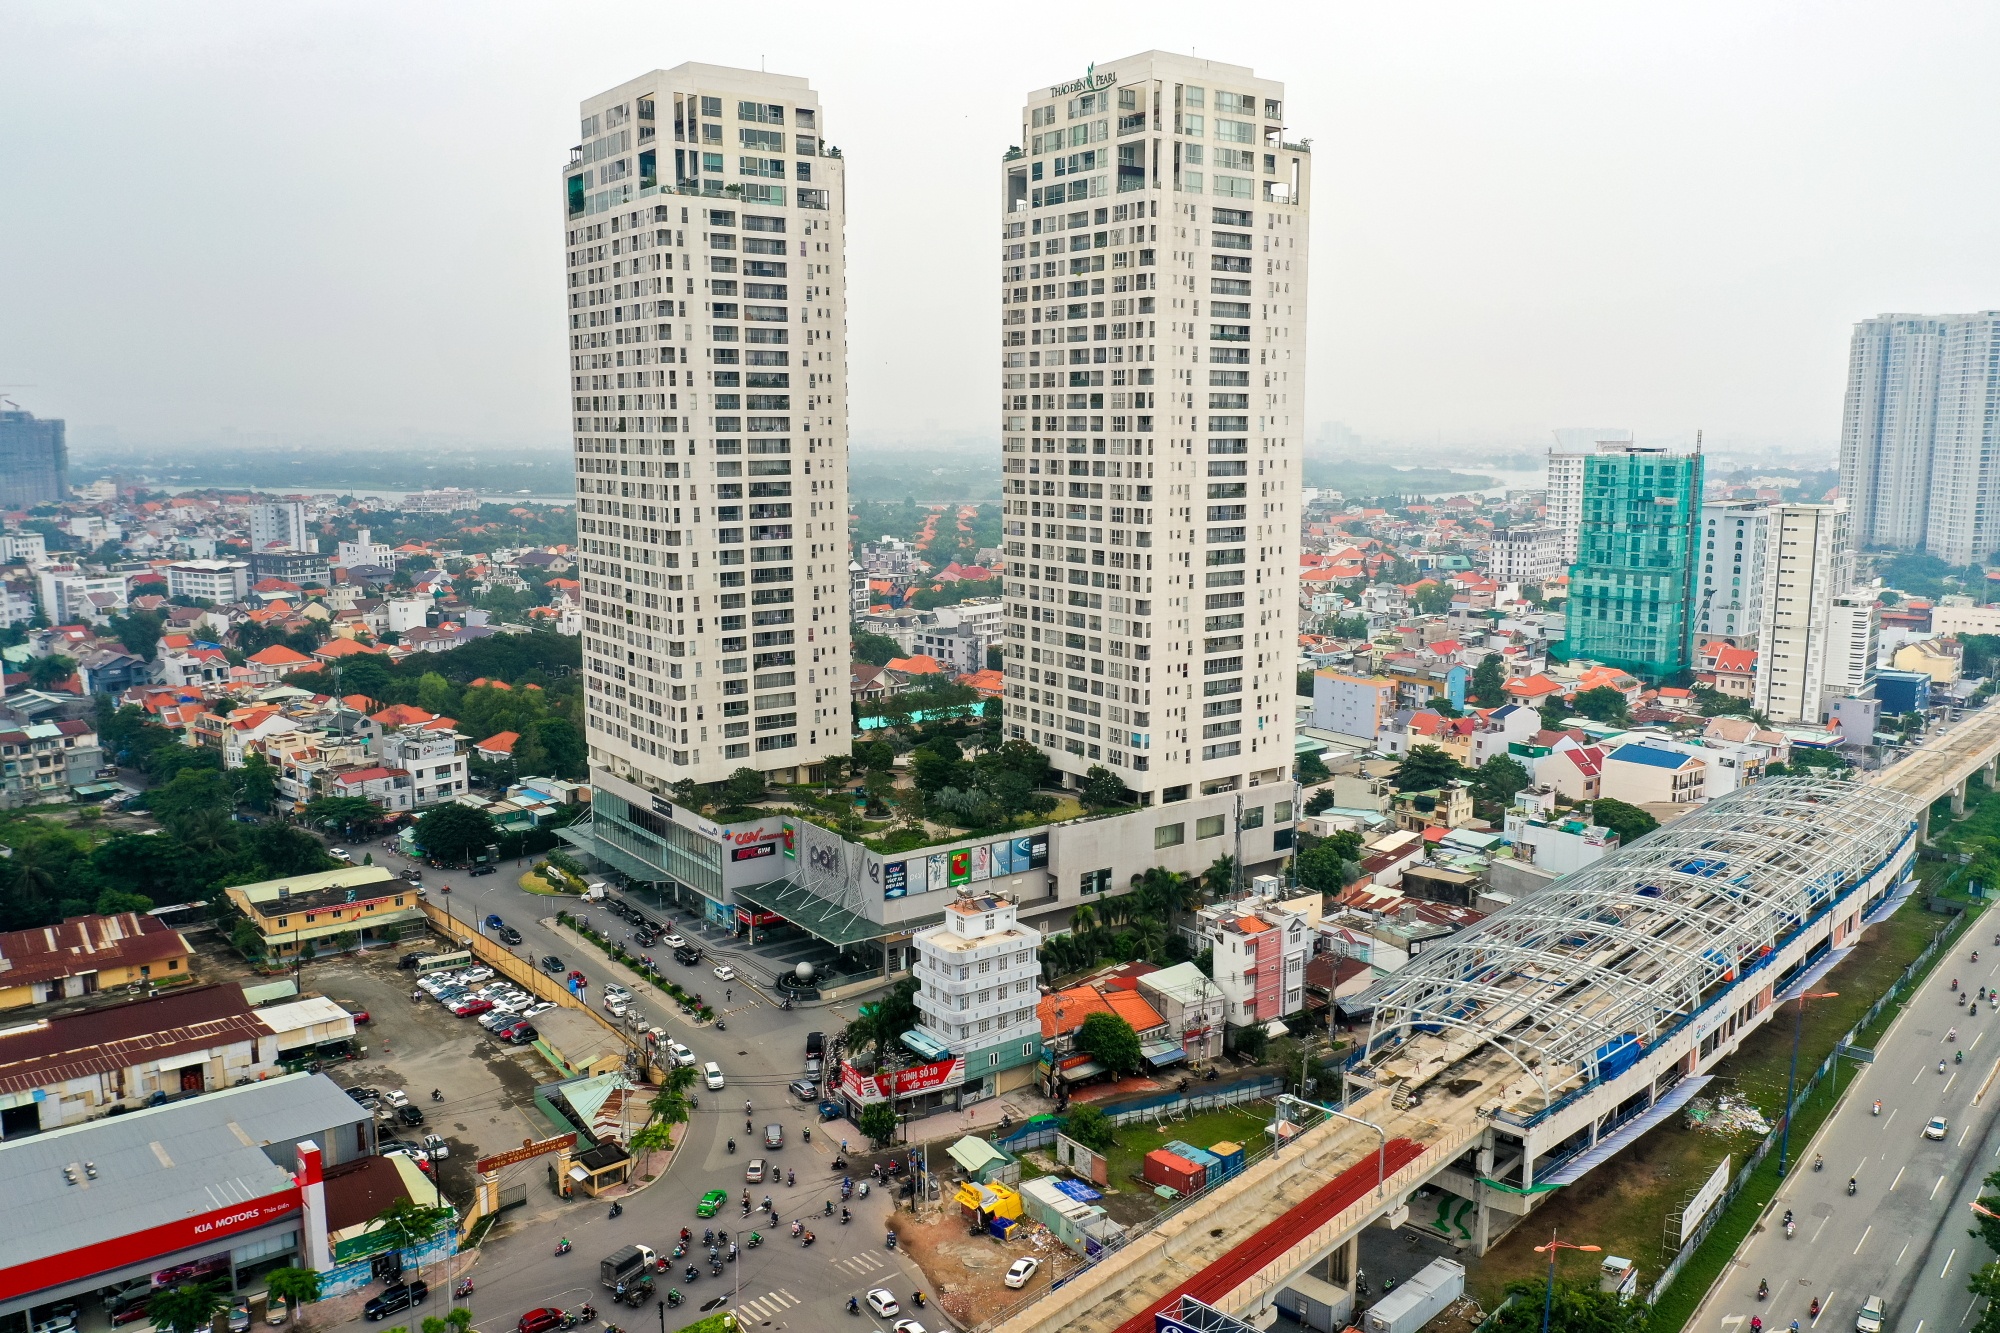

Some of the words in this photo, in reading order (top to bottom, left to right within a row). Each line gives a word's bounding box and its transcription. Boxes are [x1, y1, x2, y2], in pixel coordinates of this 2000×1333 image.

[1095, 72, 1116, 86] PEARL
[735, 829, 762, 845] CGV
[757, 846, 771, 855] GYM
[952, 853, 969, 876] C
[919, 1065, 929, 1079] SỐ
[929, 1067, 938, 1076] 10
[487, 1160, 507, 1169] KHO
[194, 1222, 213, 1234] KIA
[215, 1208, 260, 1229] MOTORS
[263, 1205, 277, 1214] Thảo
